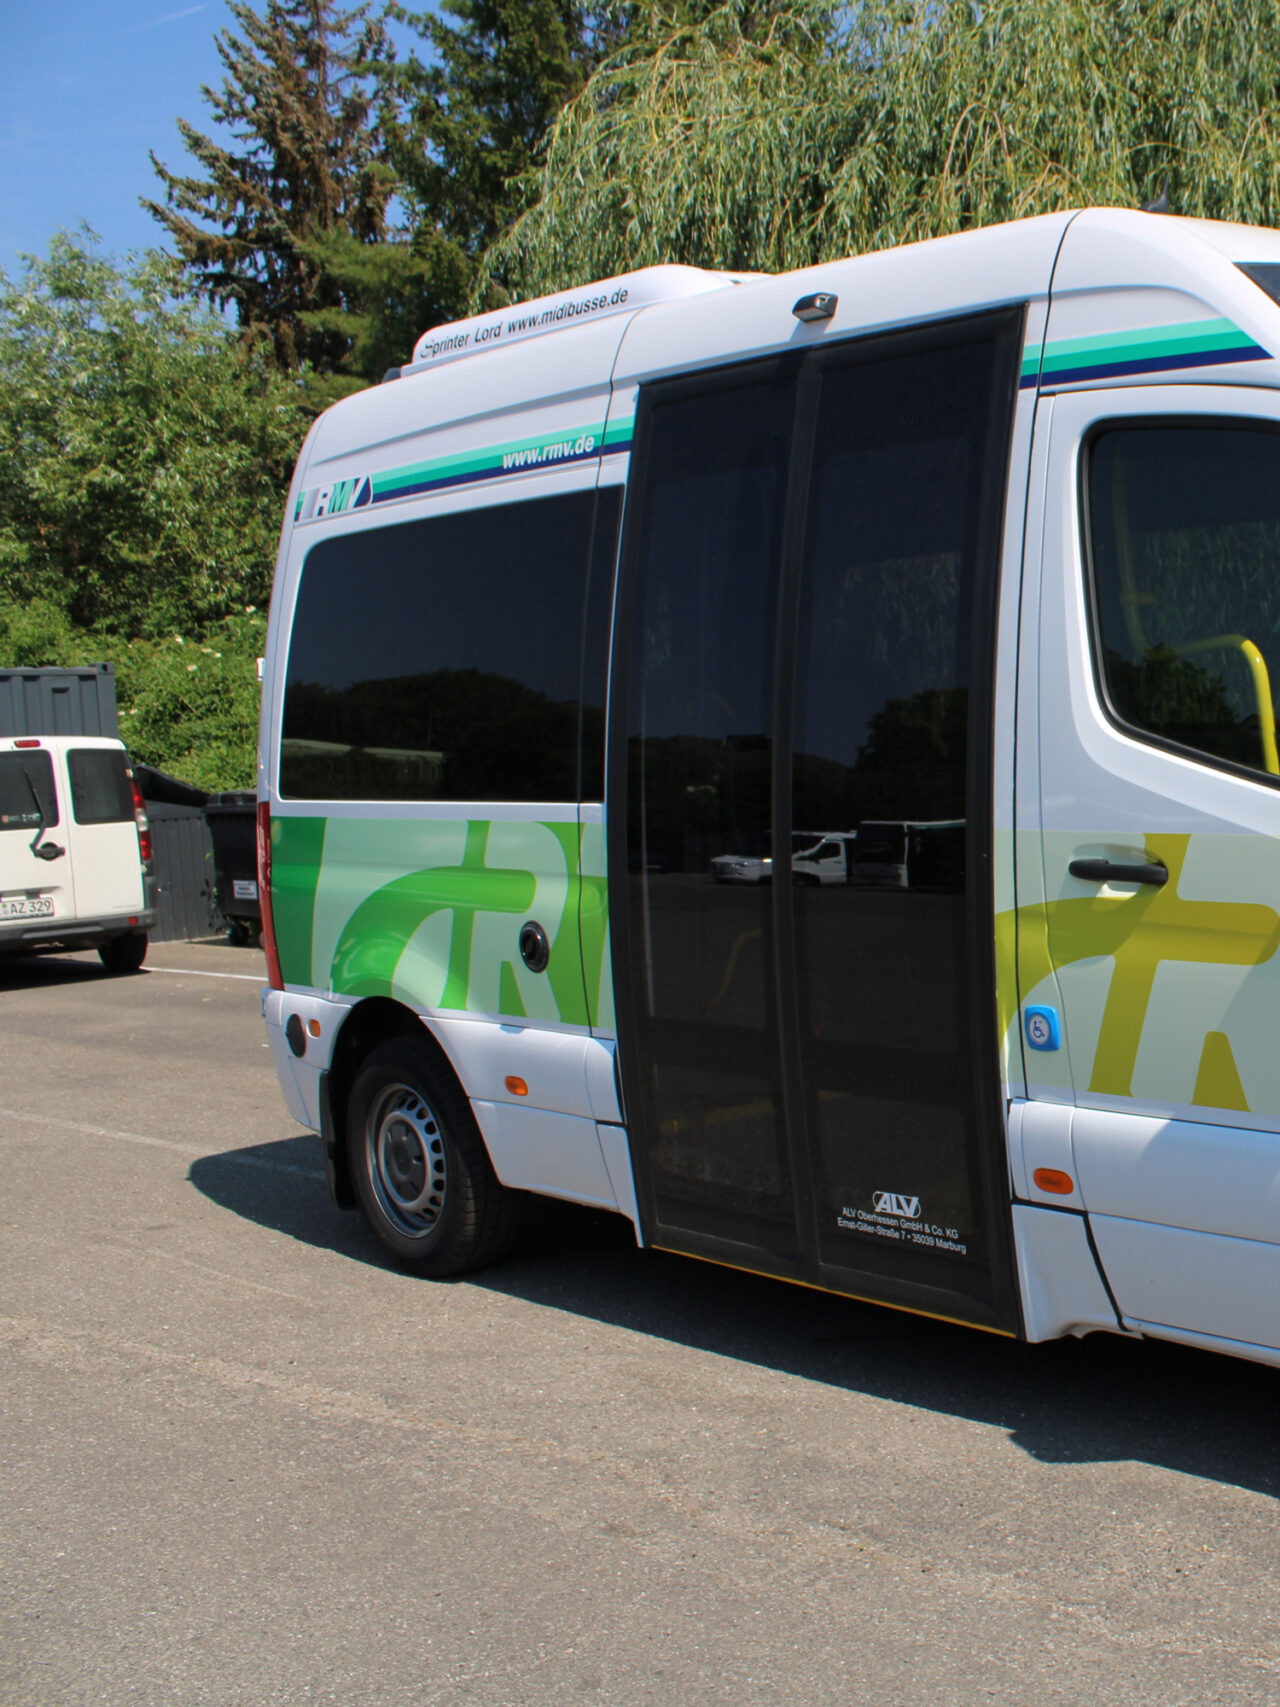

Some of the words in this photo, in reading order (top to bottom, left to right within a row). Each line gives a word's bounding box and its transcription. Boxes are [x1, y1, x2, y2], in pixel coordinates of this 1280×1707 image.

[474, 321, 503, 343] Lord
[507, 288, 629, 334] www.midibusse.de
[502, 434, 596, 470] www.rmv.de
[312, 475, 368, 519] RMV
[10, 902, 26, 915] AZ
[28, 899, 51, 913] 329
[874, 1191, 920, 1218] ALV
[842, 1207, 857, 1219] ALV
[857, 1209, 899, 1227] Oberhessen
[900, 1219, 923, 1232] GmbH
[924, 1223, 931, 1234] &
[931, 1225, 945, 1237] Co.
[945, 1228, 959, 1240] KG
[911, 1232, 935, 1247] 35039
[935, 1239, 967, 1255] Marburg
